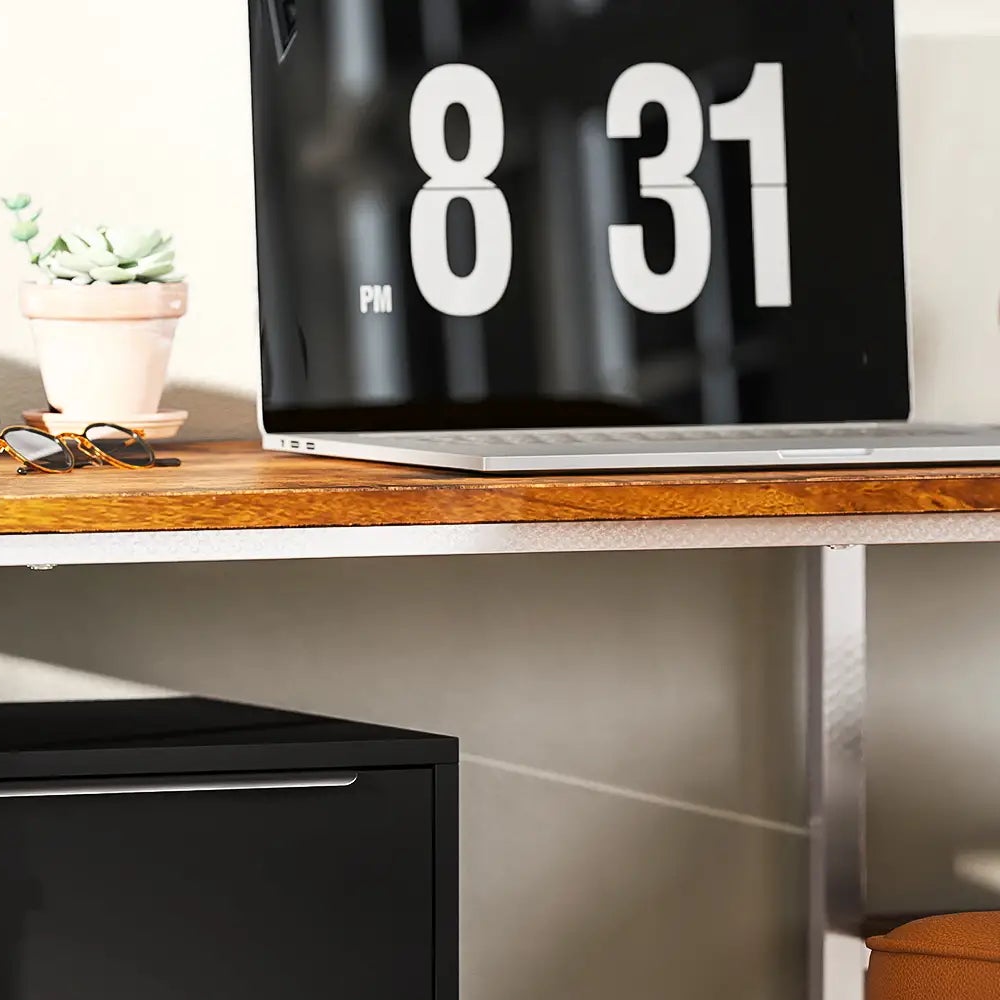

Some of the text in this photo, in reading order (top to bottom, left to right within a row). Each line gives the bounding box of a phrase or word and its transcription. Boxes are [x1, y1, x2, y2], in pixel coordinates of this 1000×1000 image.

[409, 61, 792, 317] 8 31
[359, 284, 393, 314] PM
